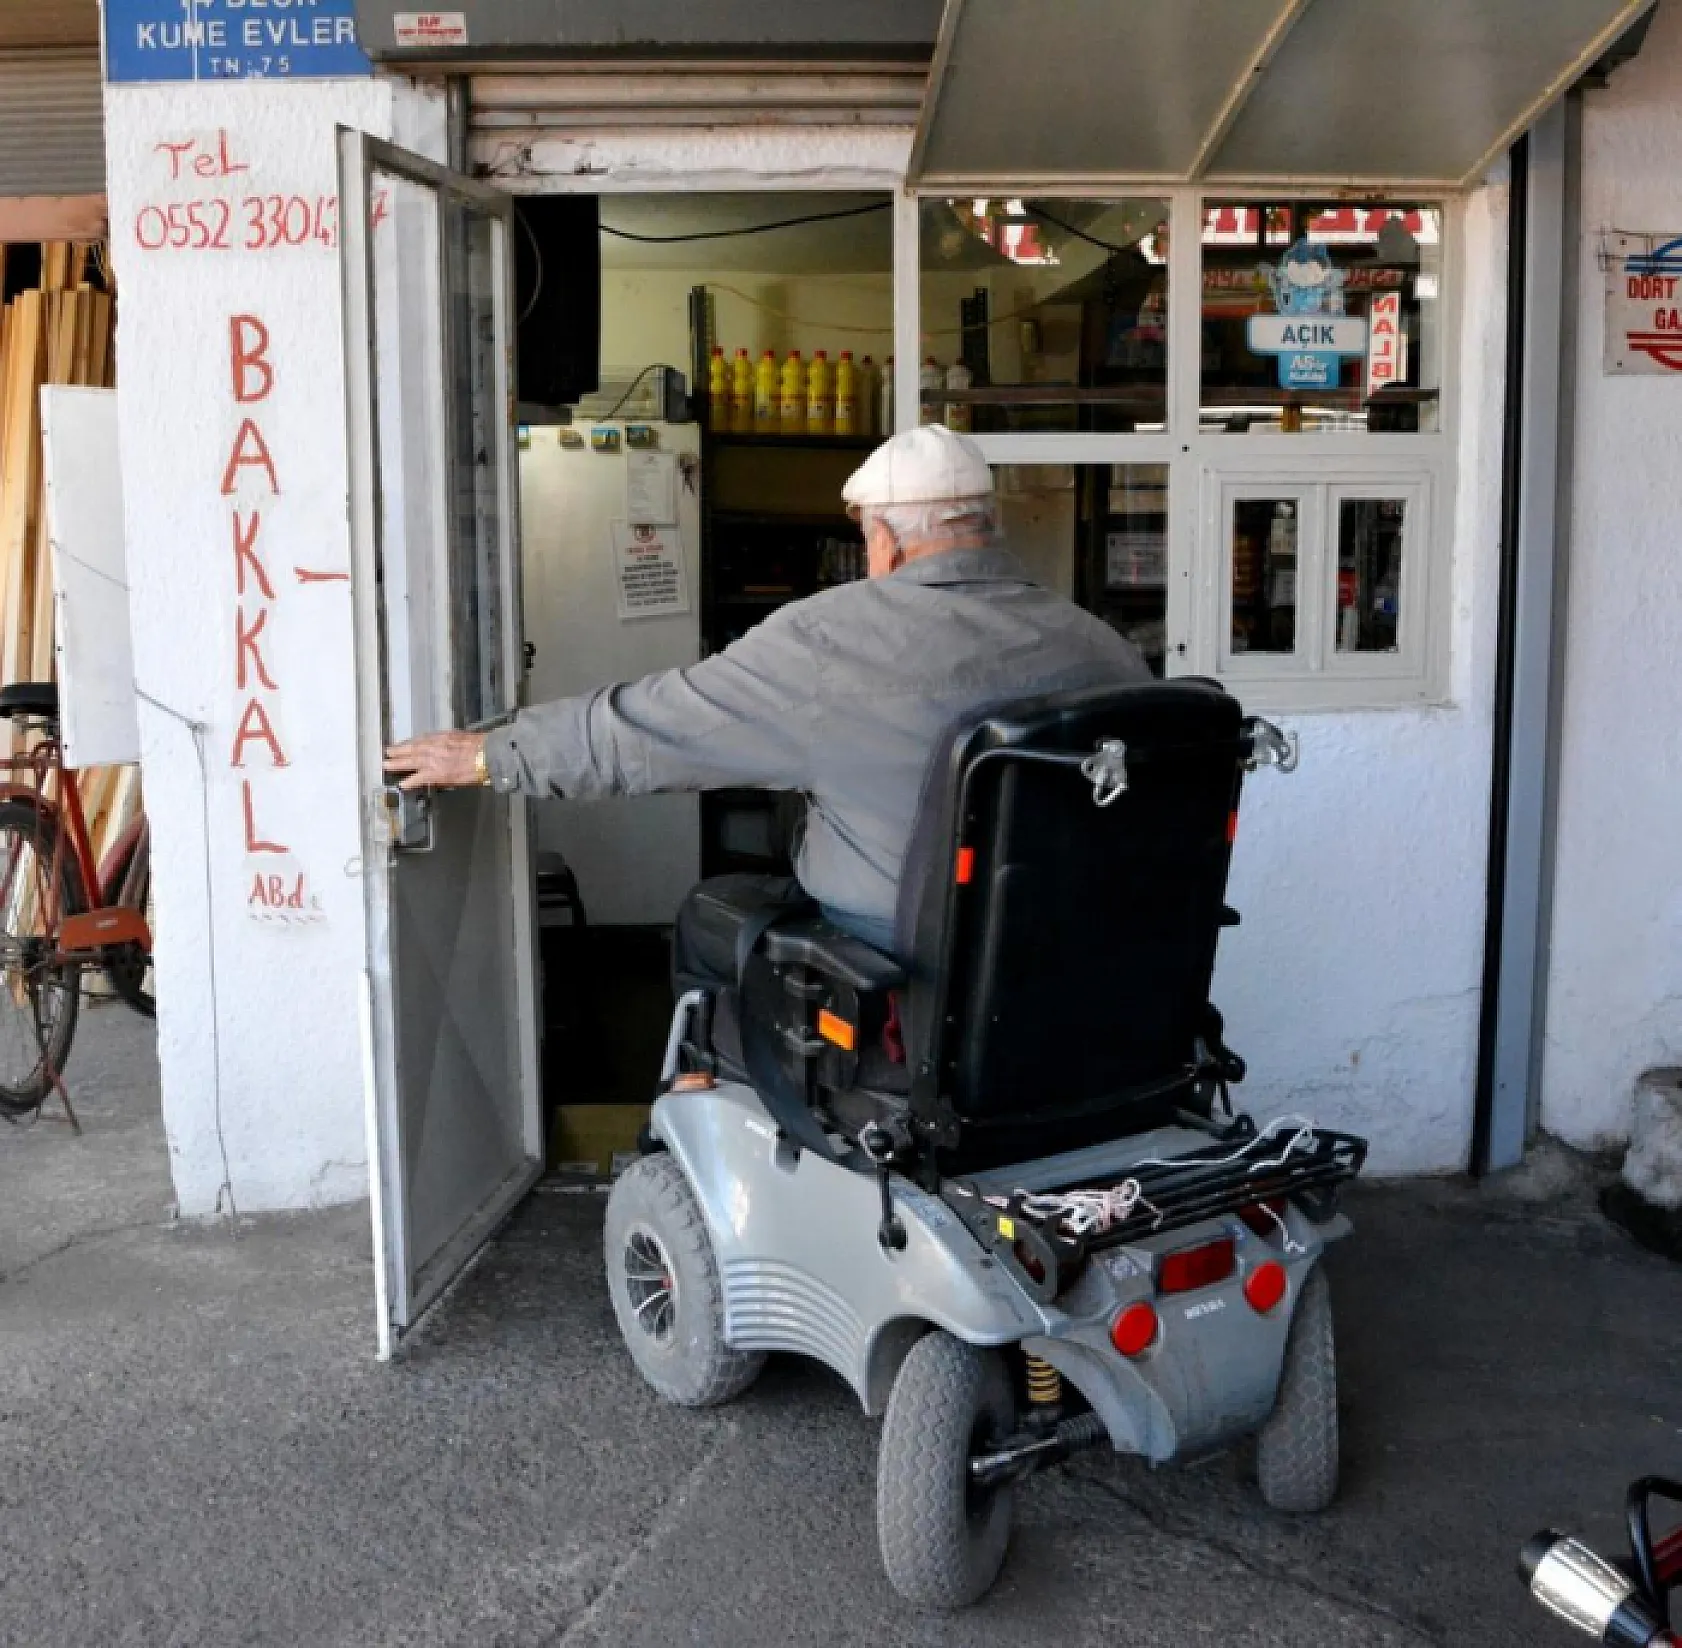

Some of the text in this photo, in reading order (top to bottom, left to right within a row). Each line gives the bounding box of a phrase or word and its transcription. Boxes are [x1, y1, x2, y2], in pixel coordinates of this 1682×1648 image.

[136, 199, 231, 250] 0552
[1280, 324, 1335, 349] AÇIK
[219, 314, 291, 854] BAKKAL
